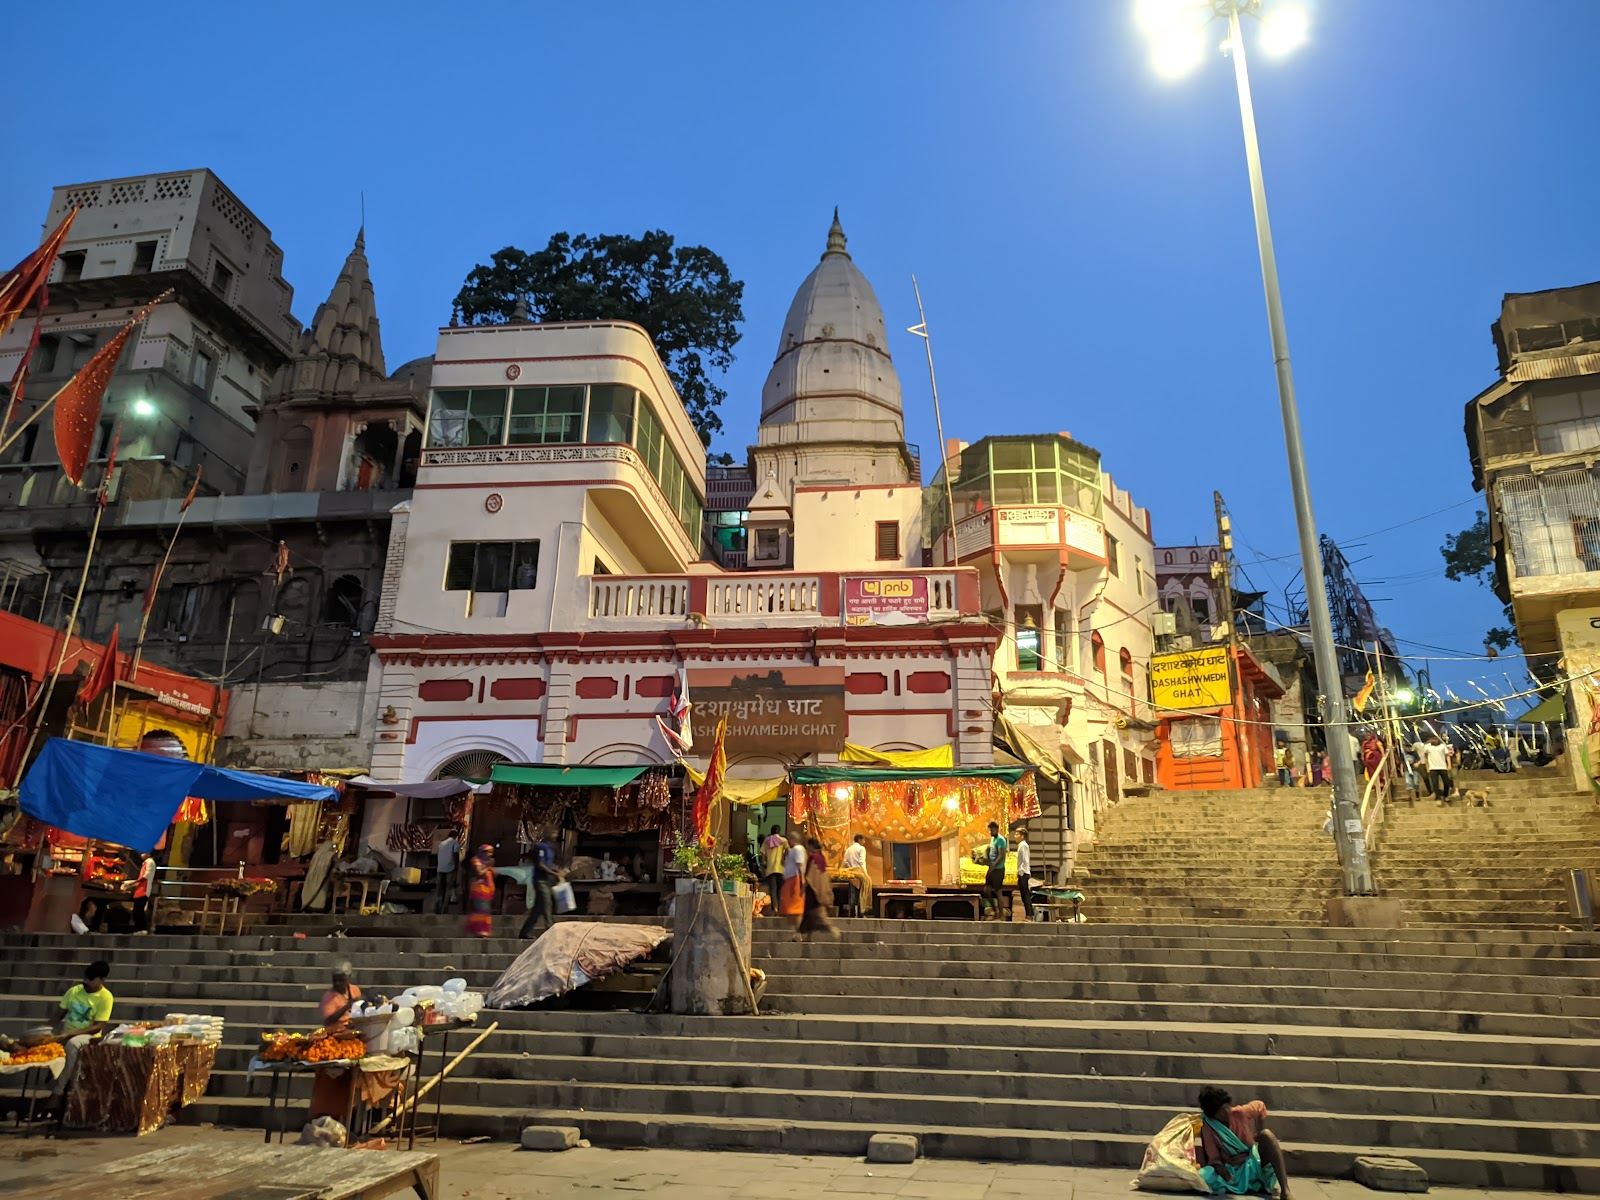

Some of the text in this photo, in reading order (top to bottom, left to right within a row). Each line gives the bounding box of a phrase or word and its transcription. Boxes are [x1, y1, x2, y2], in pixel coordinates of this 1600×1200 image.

[884, 581, 909, 595] pnb
[861, 597, 877, 605] आरती
[1207, 656, 1225, 665] घाट
[1152, 673, 1226, 688] DASHASHWMEDH
[1173, 688, 1202, 698] GHAT
[694, 694, 823, 720] दशाश्वमेध घाट
[692, 724, 837, 737] ASHSHVAMEDH GHAT
